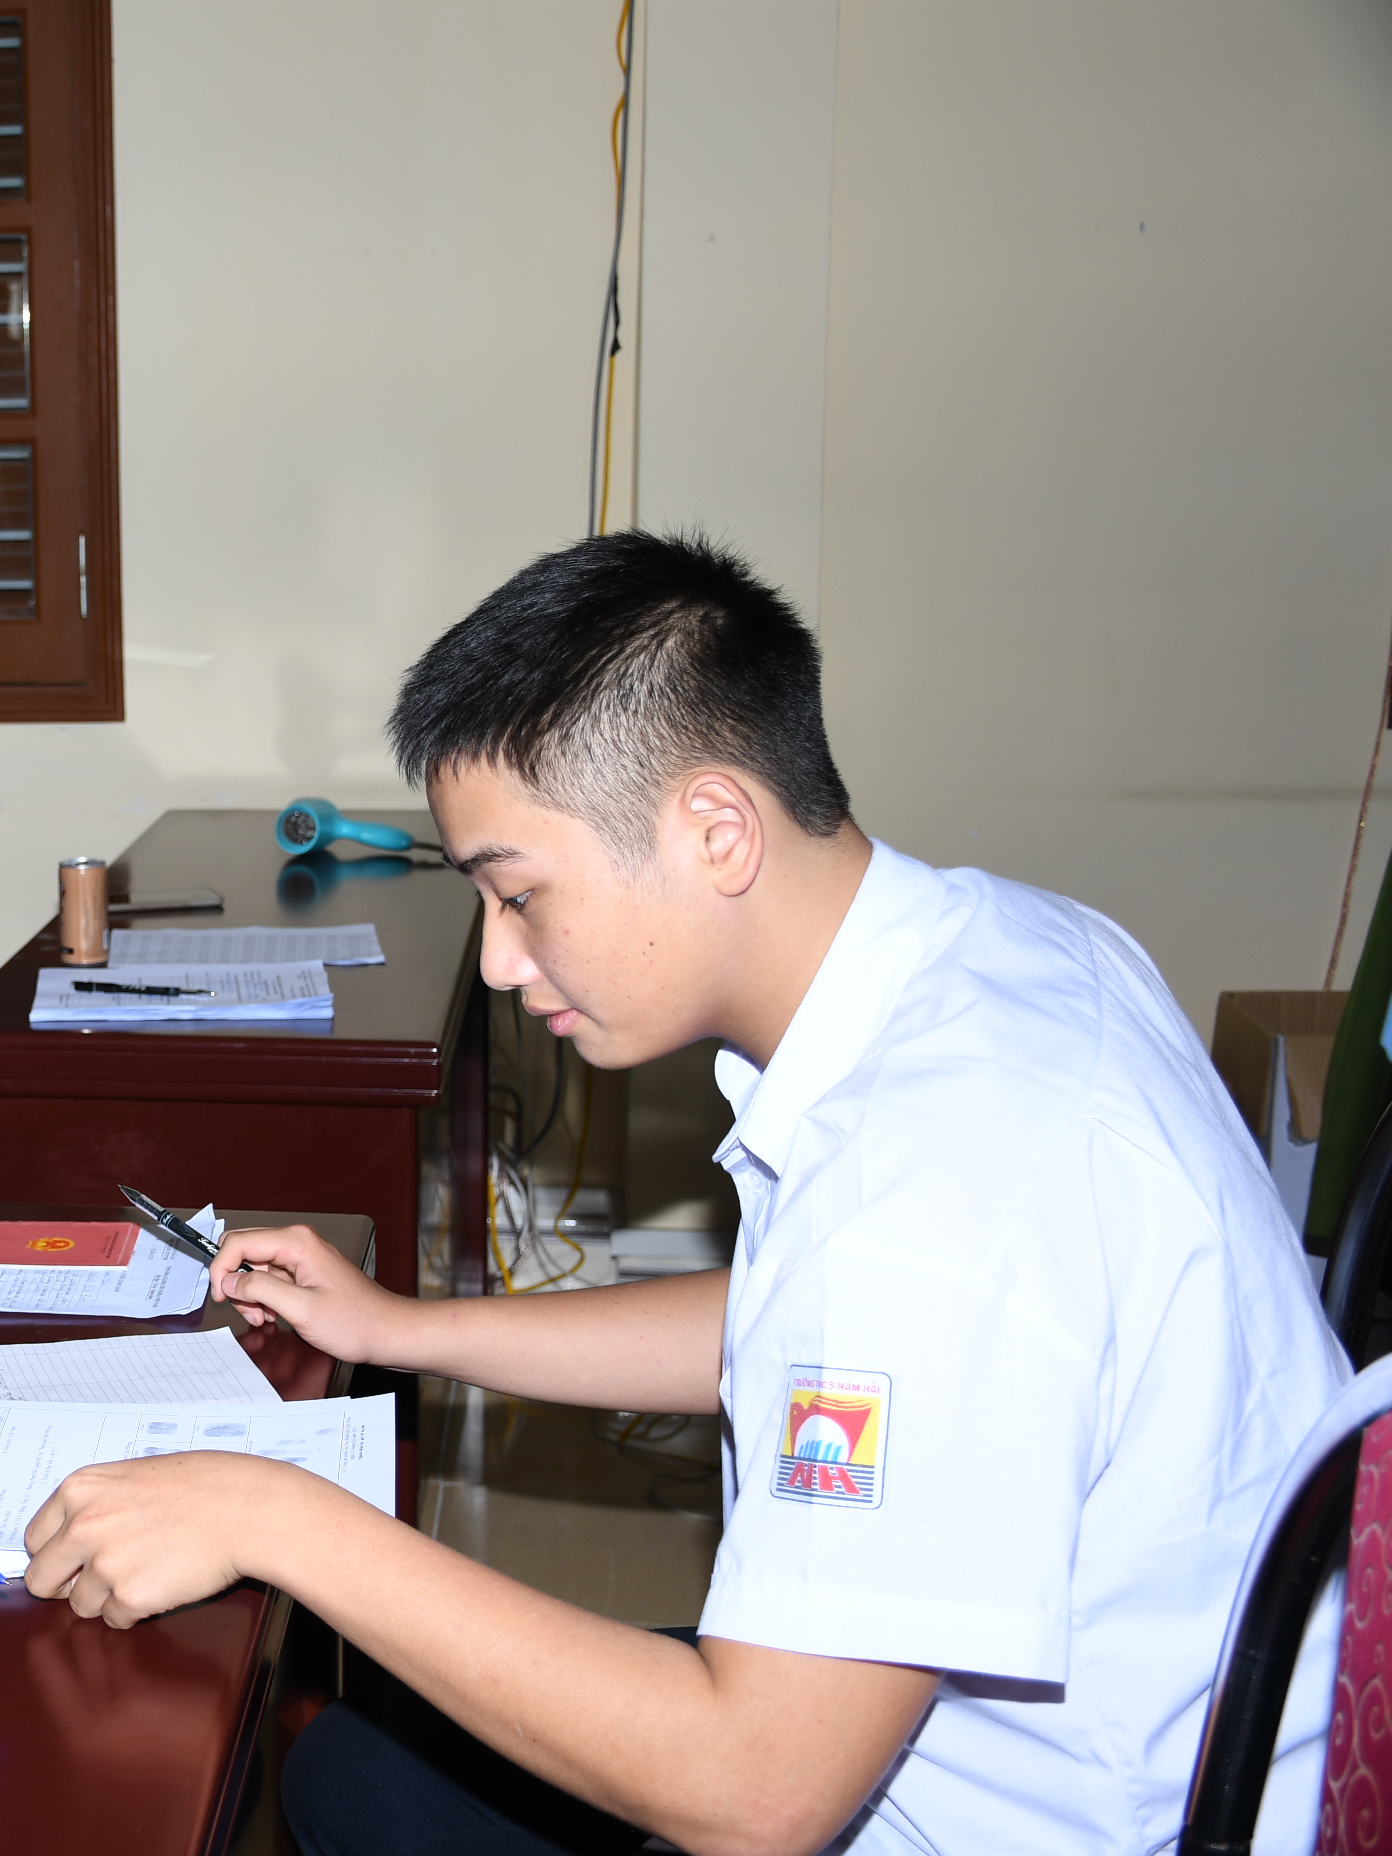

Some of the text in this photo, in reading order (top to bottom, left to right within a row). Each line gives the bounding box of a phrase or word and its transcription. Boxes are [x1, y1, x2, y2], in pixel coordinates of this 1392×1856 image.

[793, 1377, 815, 1388] TRƯỜNG
[837, 1382, 860, 1392] NAM
[863, 1381, 881, 1394] HẢI
[785, 1461, 862, 1496] NH
